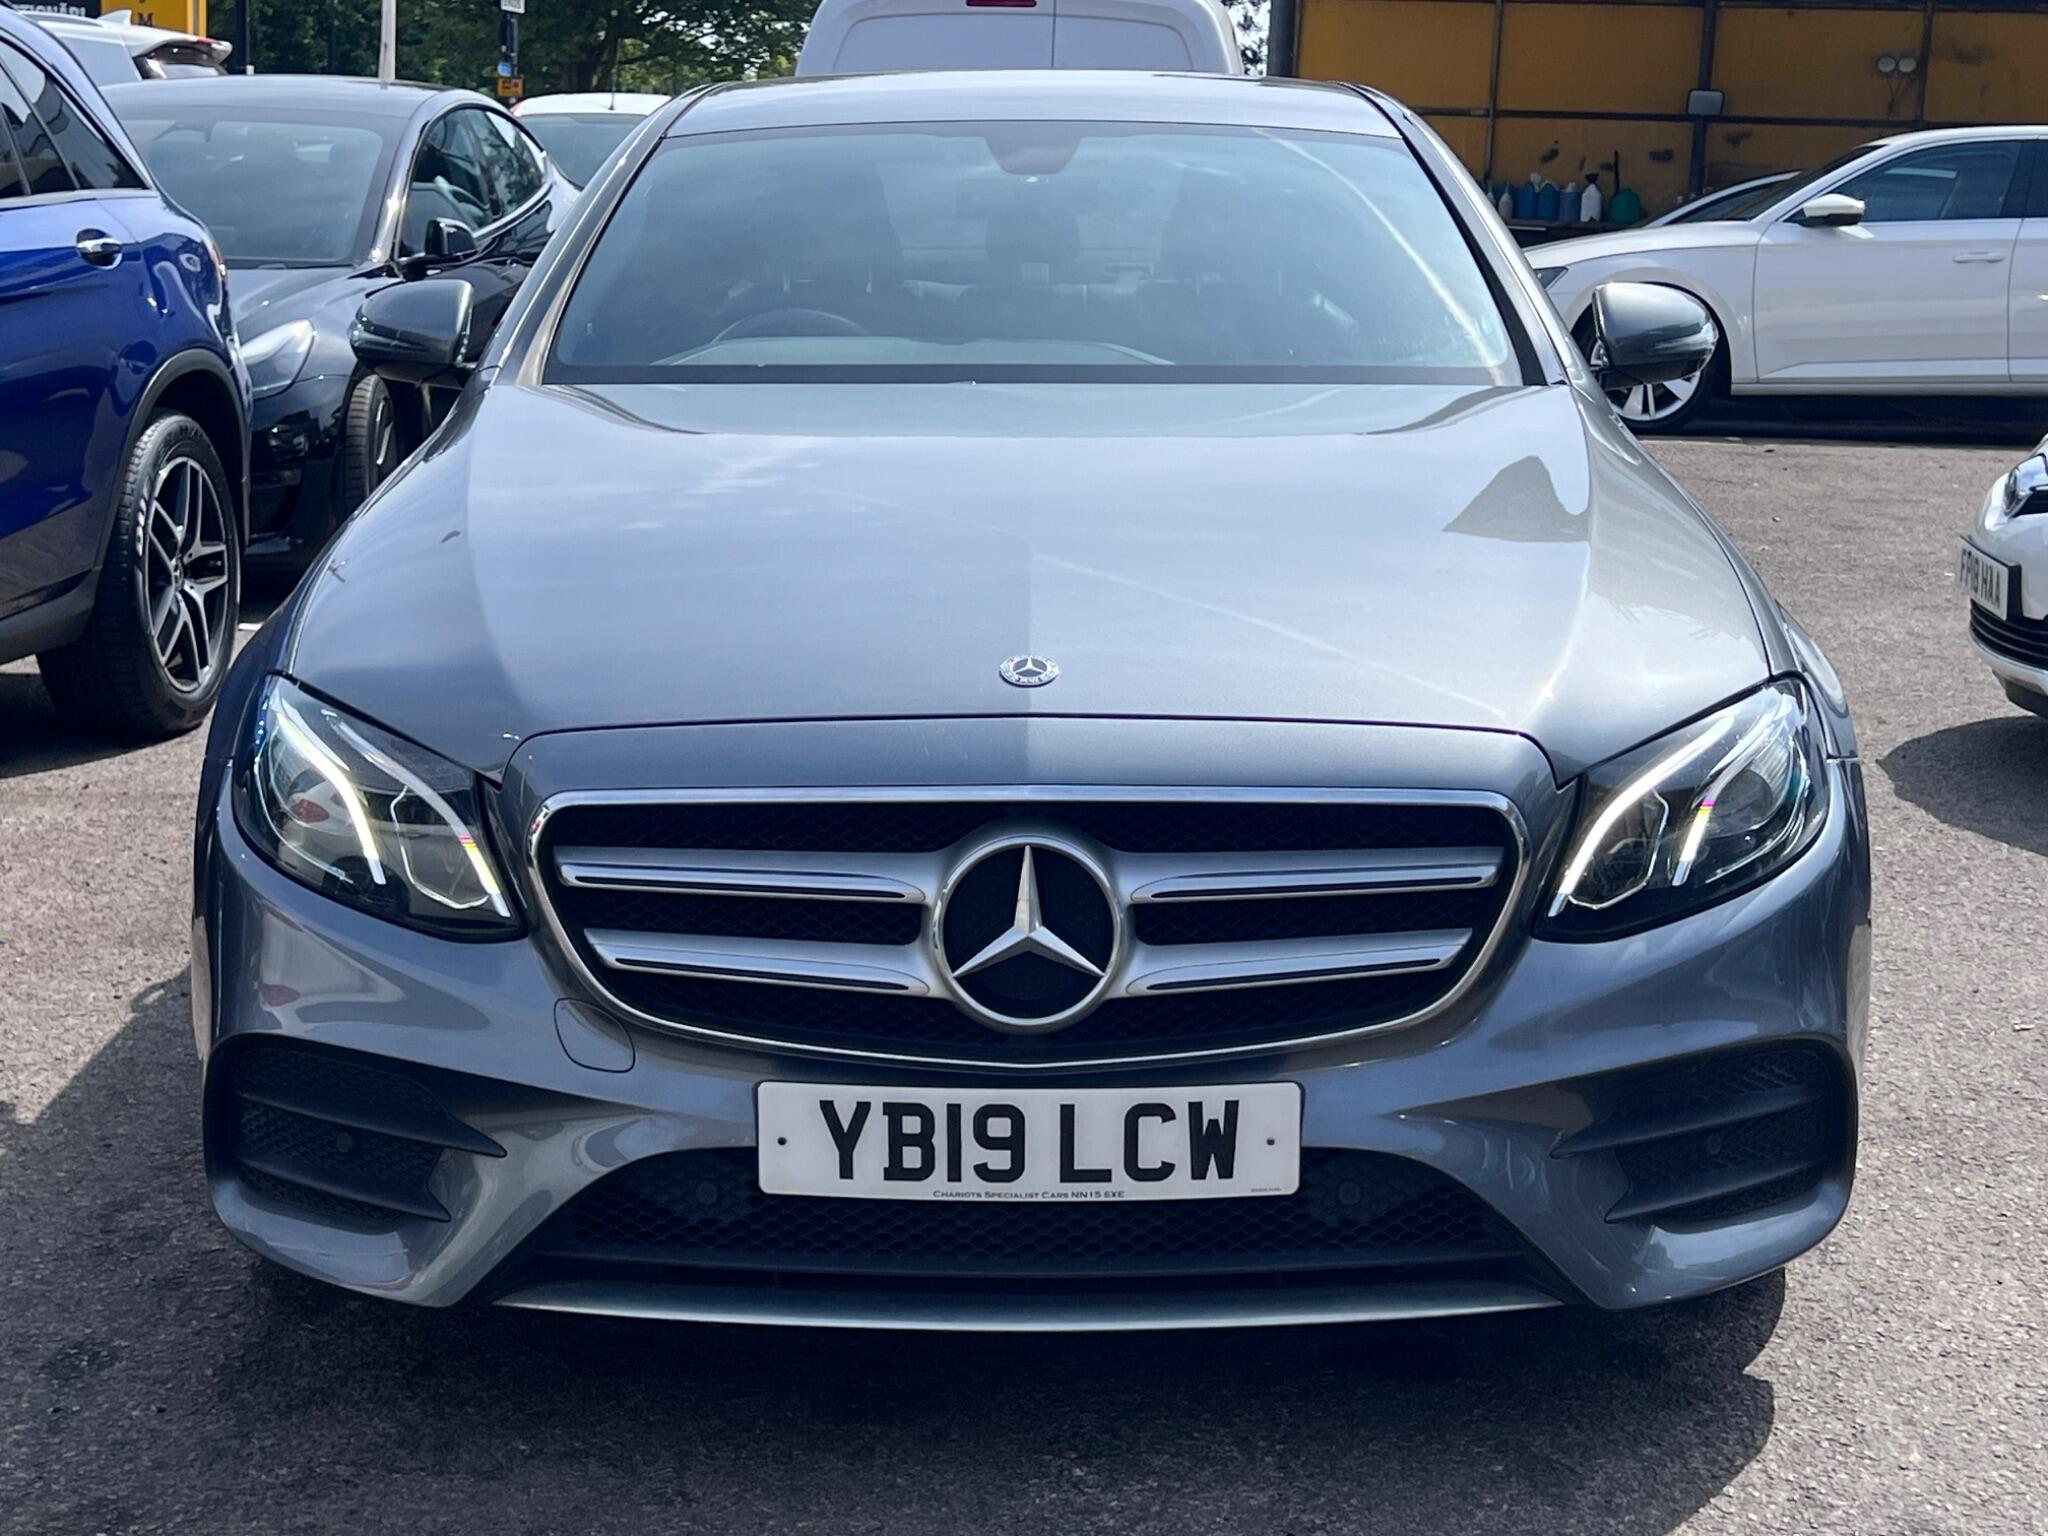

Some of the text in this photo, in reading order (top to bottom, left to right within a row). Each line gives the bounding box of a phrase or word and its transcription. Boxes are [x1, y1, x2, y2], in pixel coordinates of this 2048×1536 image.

[819, 1100, 1240, 1183] YB19 LCW
[1071, 1190, 1101, 1199] NN15
